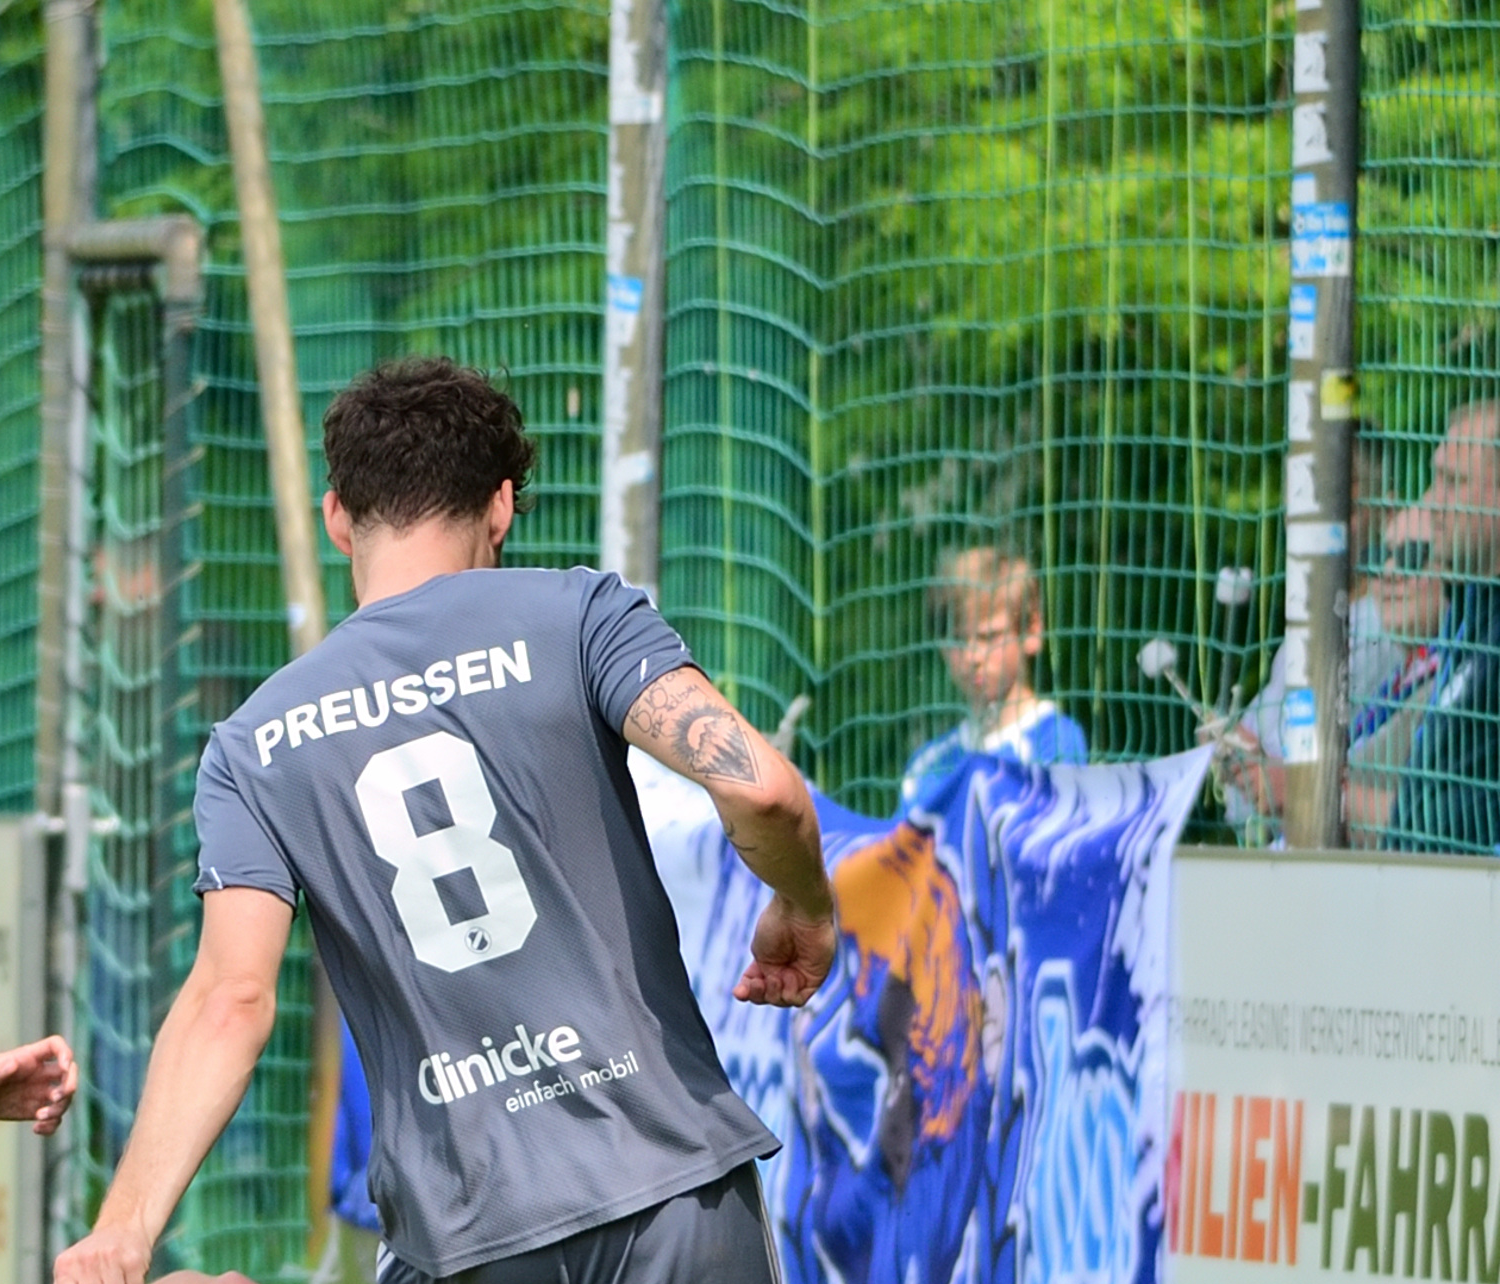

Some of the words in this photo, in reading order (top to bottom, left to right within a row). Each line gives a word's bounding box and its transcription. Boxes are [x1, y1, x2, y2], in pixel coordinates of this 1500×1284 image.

[254, 640, 532, 768] PREUSSEN
[354, 730, 538, 973] 8
[506, 1074, 576, 1112] einfach
[579, 1050, 639, 1089] mobil
